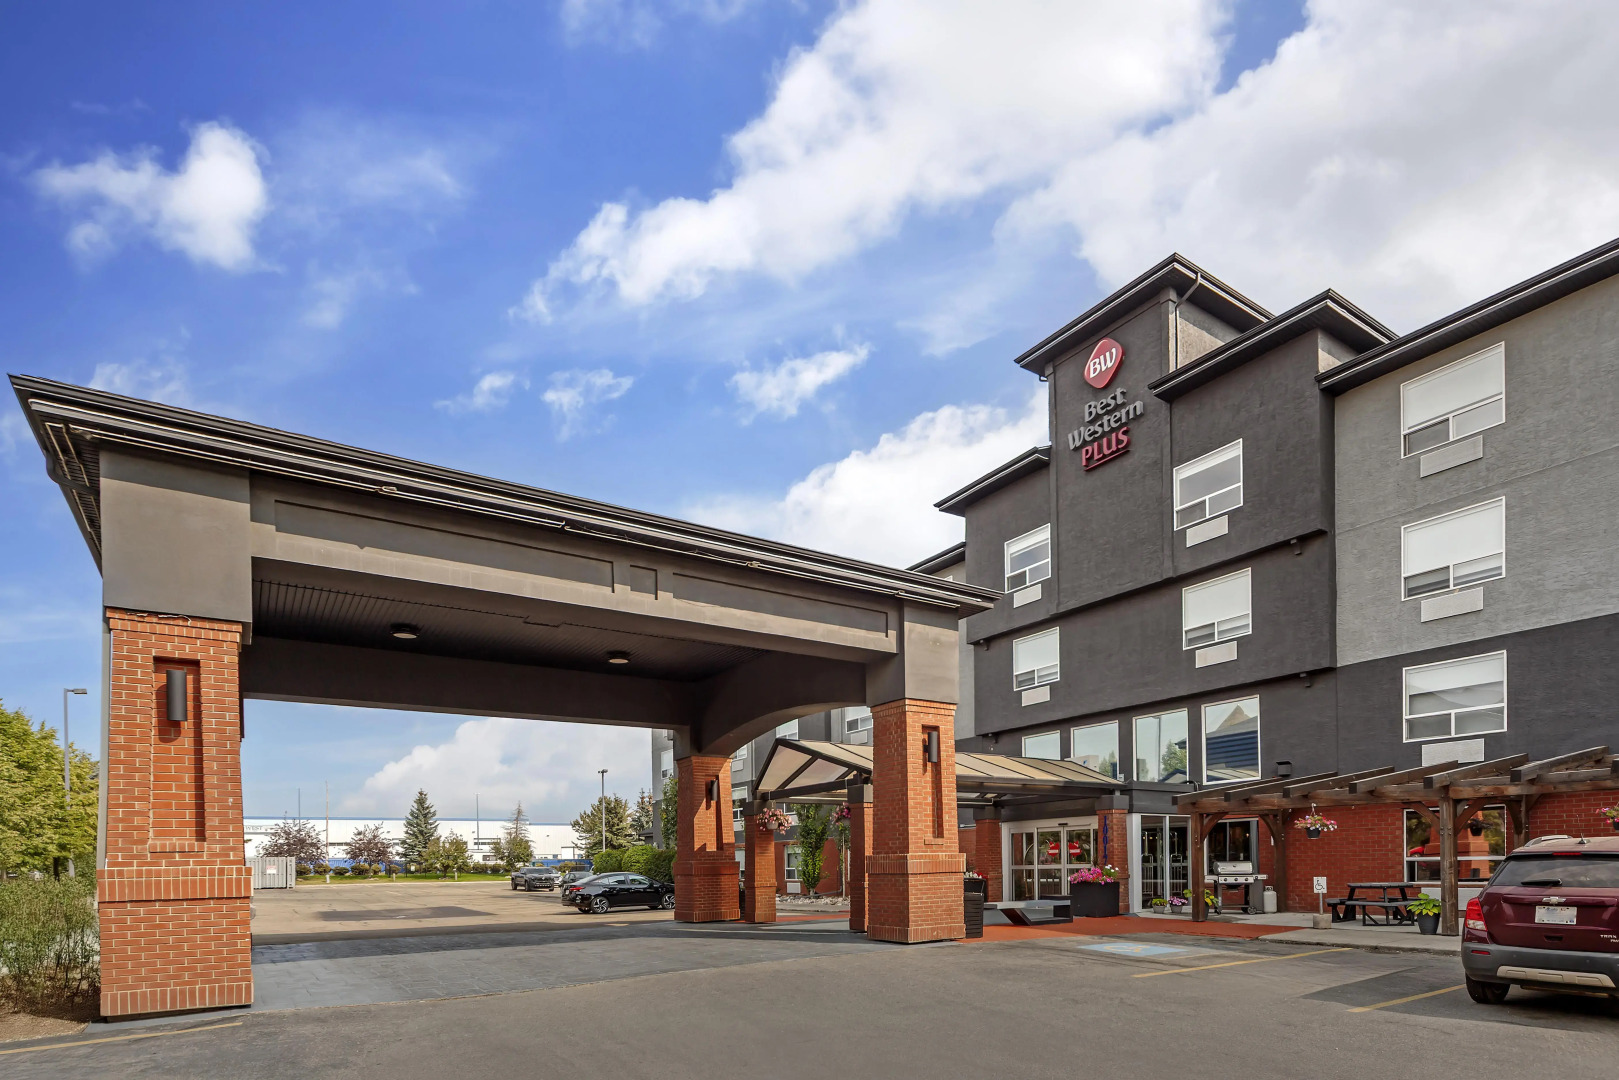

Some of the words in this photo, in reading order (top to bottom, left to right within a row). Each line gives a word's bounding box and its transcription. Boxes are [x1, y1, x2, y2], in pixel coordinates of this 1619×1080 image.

[1089, 347, 1117, 379] BW
[1084, 387, 1127, 423] Best
[1067, 400, 1144, 450] Western
[1081, 426, 1131, 467] PLUS
